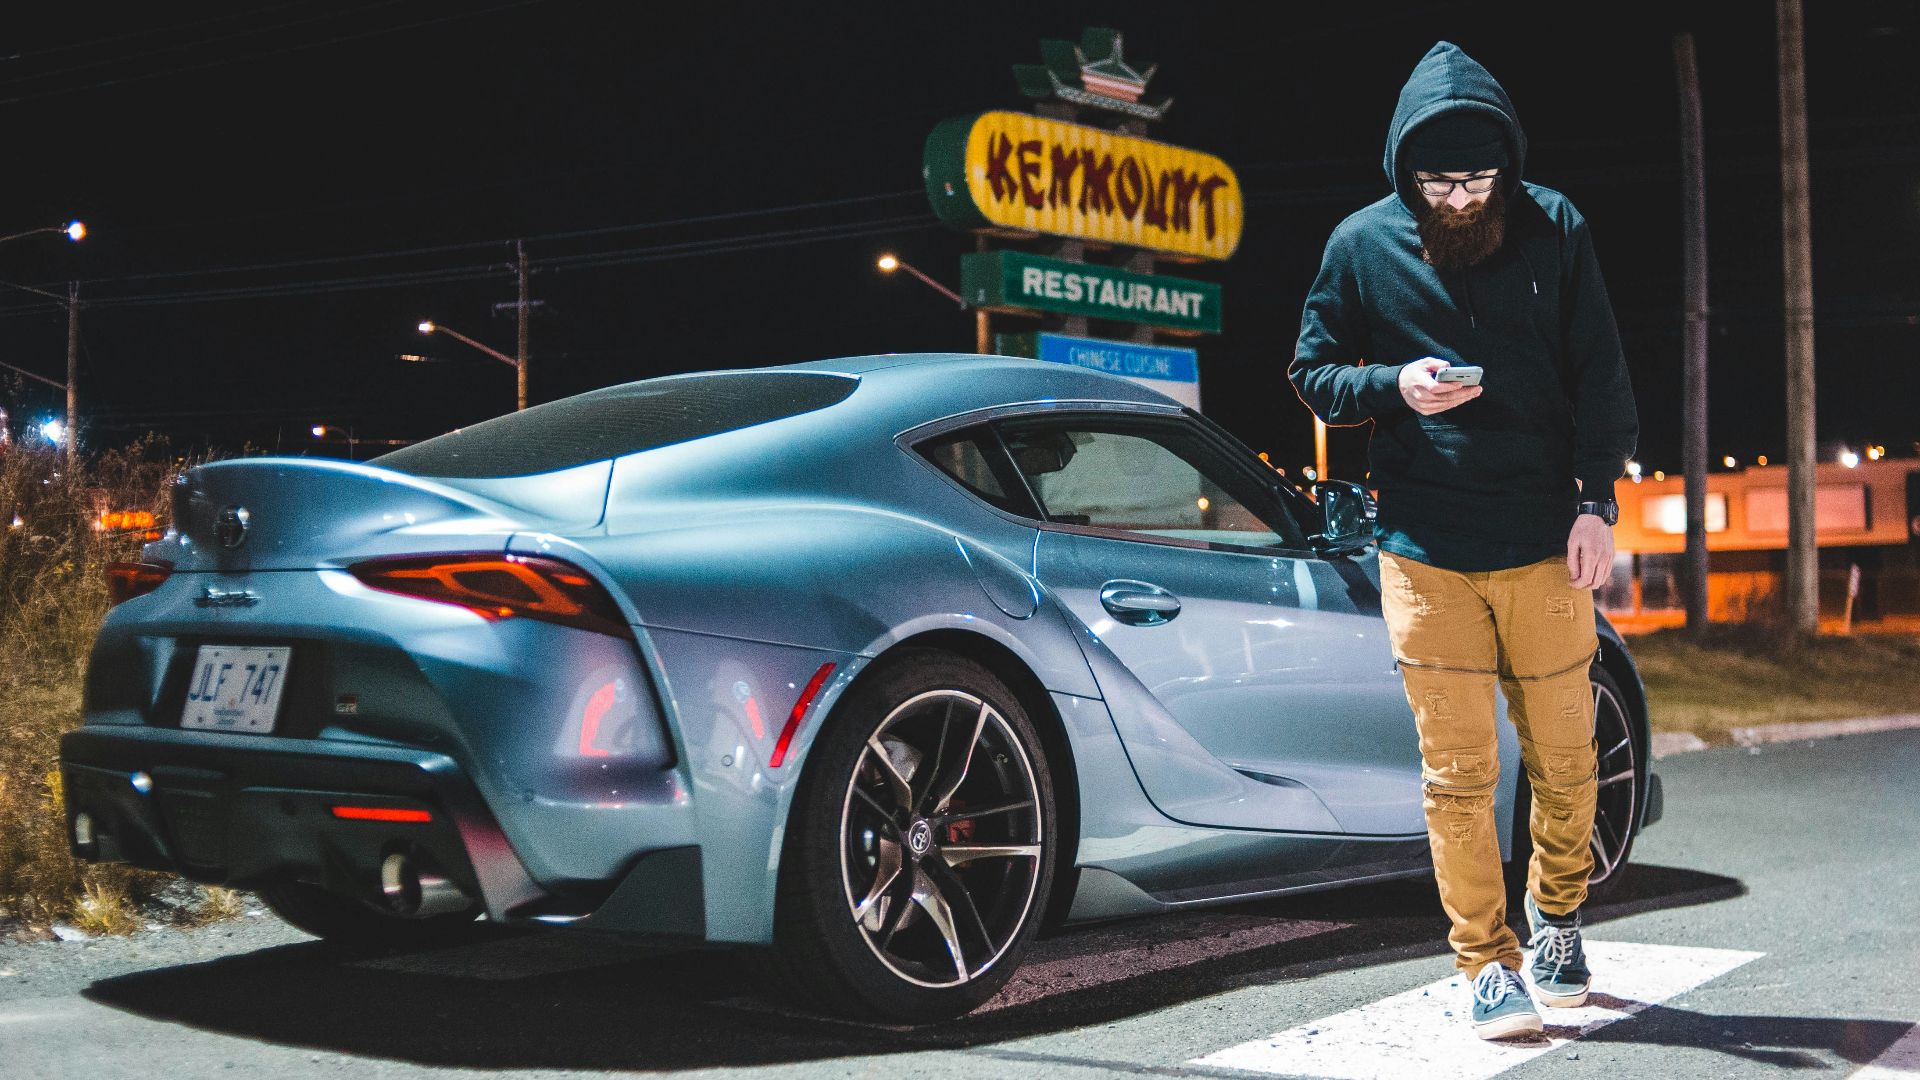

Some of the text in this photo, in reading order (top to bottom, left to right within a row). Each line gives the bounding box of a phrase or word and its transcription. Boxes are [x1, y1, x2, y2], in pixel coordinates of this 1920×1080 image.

[986, 131, 1228, 241] KENMOUNT
[1023, 267, 1204, 318] RESTAURANT
[1069, 347, 1121, 371] CHINESE
[189, 663, 280, 705] JLF 747
